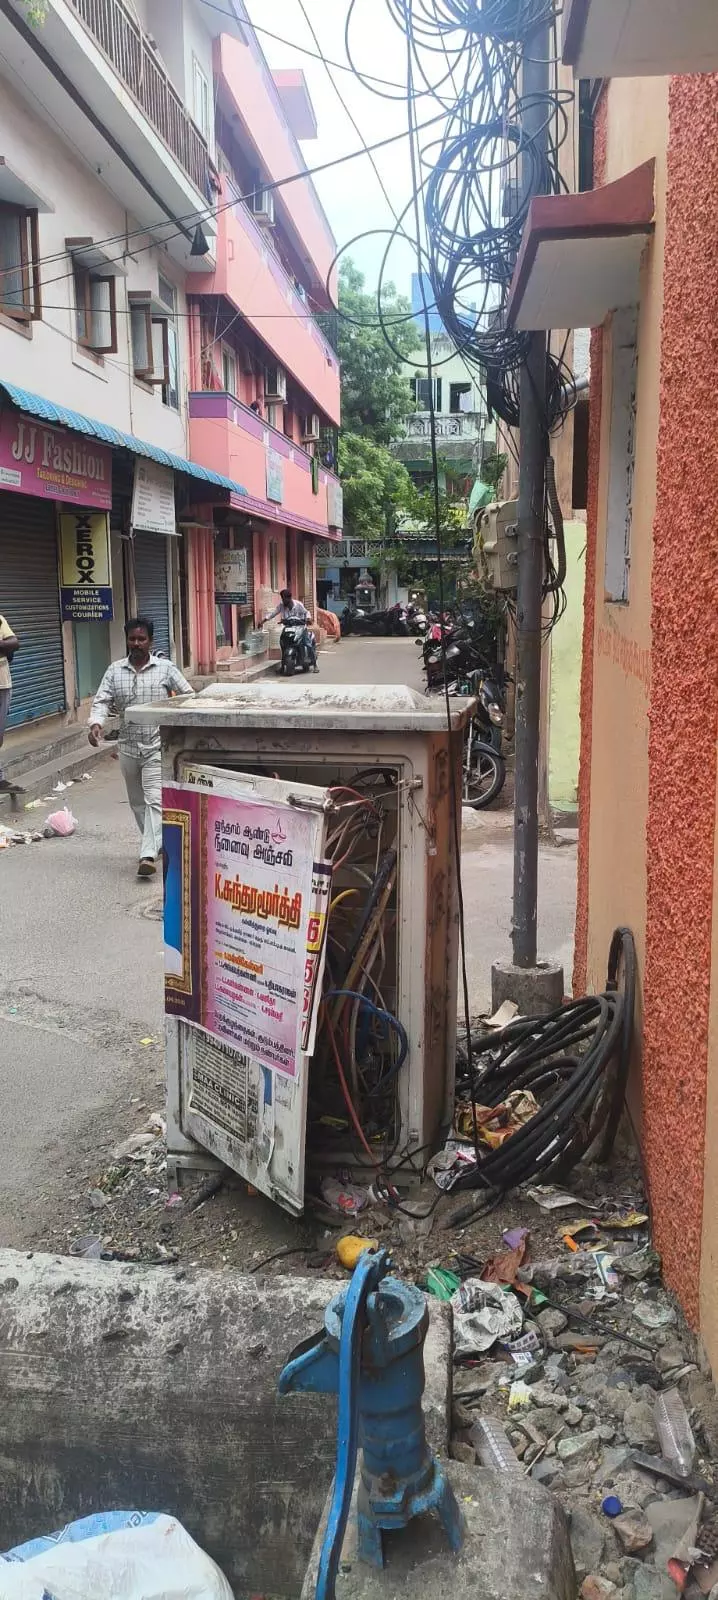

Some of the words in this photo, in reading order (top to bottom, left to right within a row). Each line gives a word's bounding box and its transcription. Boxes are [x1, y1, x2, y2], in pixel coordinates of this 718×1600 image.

[11, 423, 37, 463] JJ
[41, 430, 105, 480] Fashion
[75, 515, 95, 583] XEROX
[72, 610, 103, 618] COURIER
[214, 819, 241, 835] ஐந்தாம்
[242, 825, 271, 844] ஆண்டு
[214, 833, 250, 860] நினைவு
[252, 843, 294, 867] அஞ்சலி
